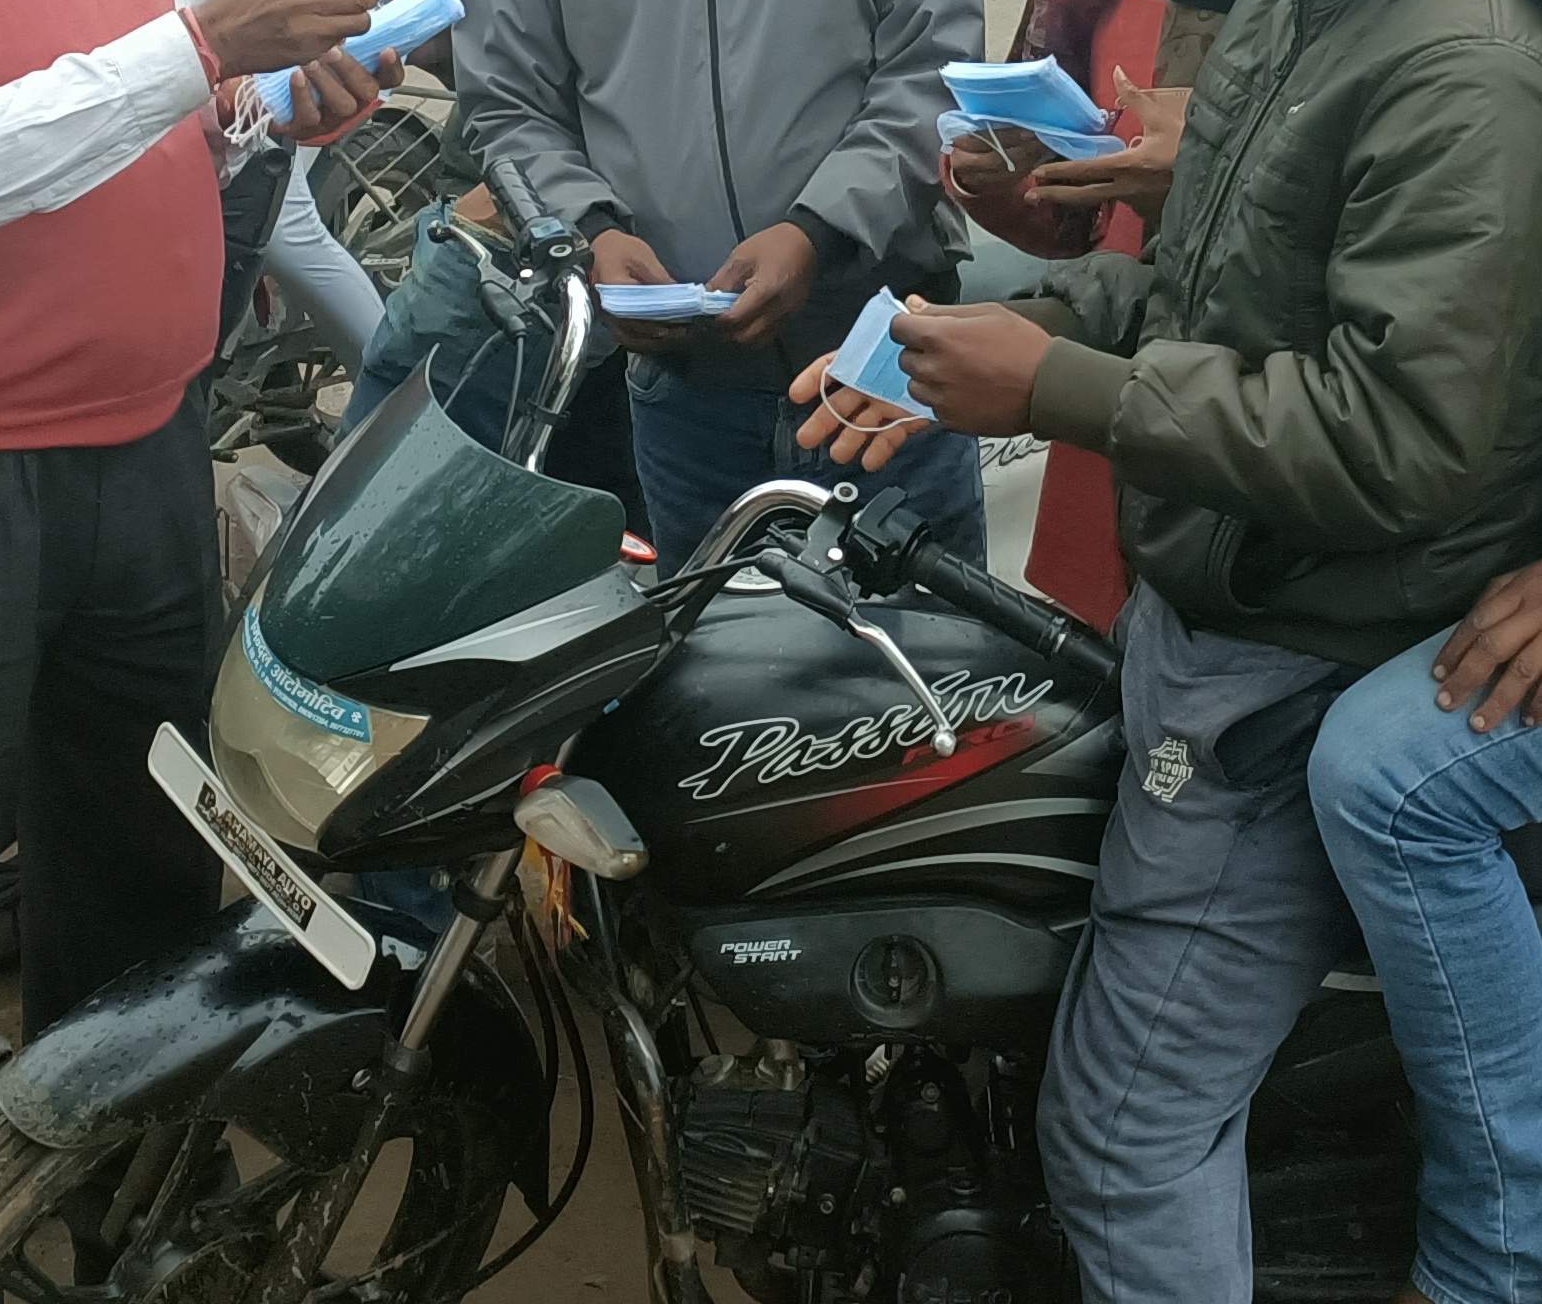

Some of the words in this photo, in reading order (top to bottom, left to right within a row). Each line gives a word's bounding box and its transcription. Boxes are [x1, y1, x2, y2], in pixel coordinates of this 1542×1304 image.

[270, 664, 346, 719] ऑटोमोटिव
[223, 808, 276, 874] AHAMAYA
[278, 872, 312, 910] AUTO
[720, 939, 792, 955] POWER
[732, 949, 802, 964] START
